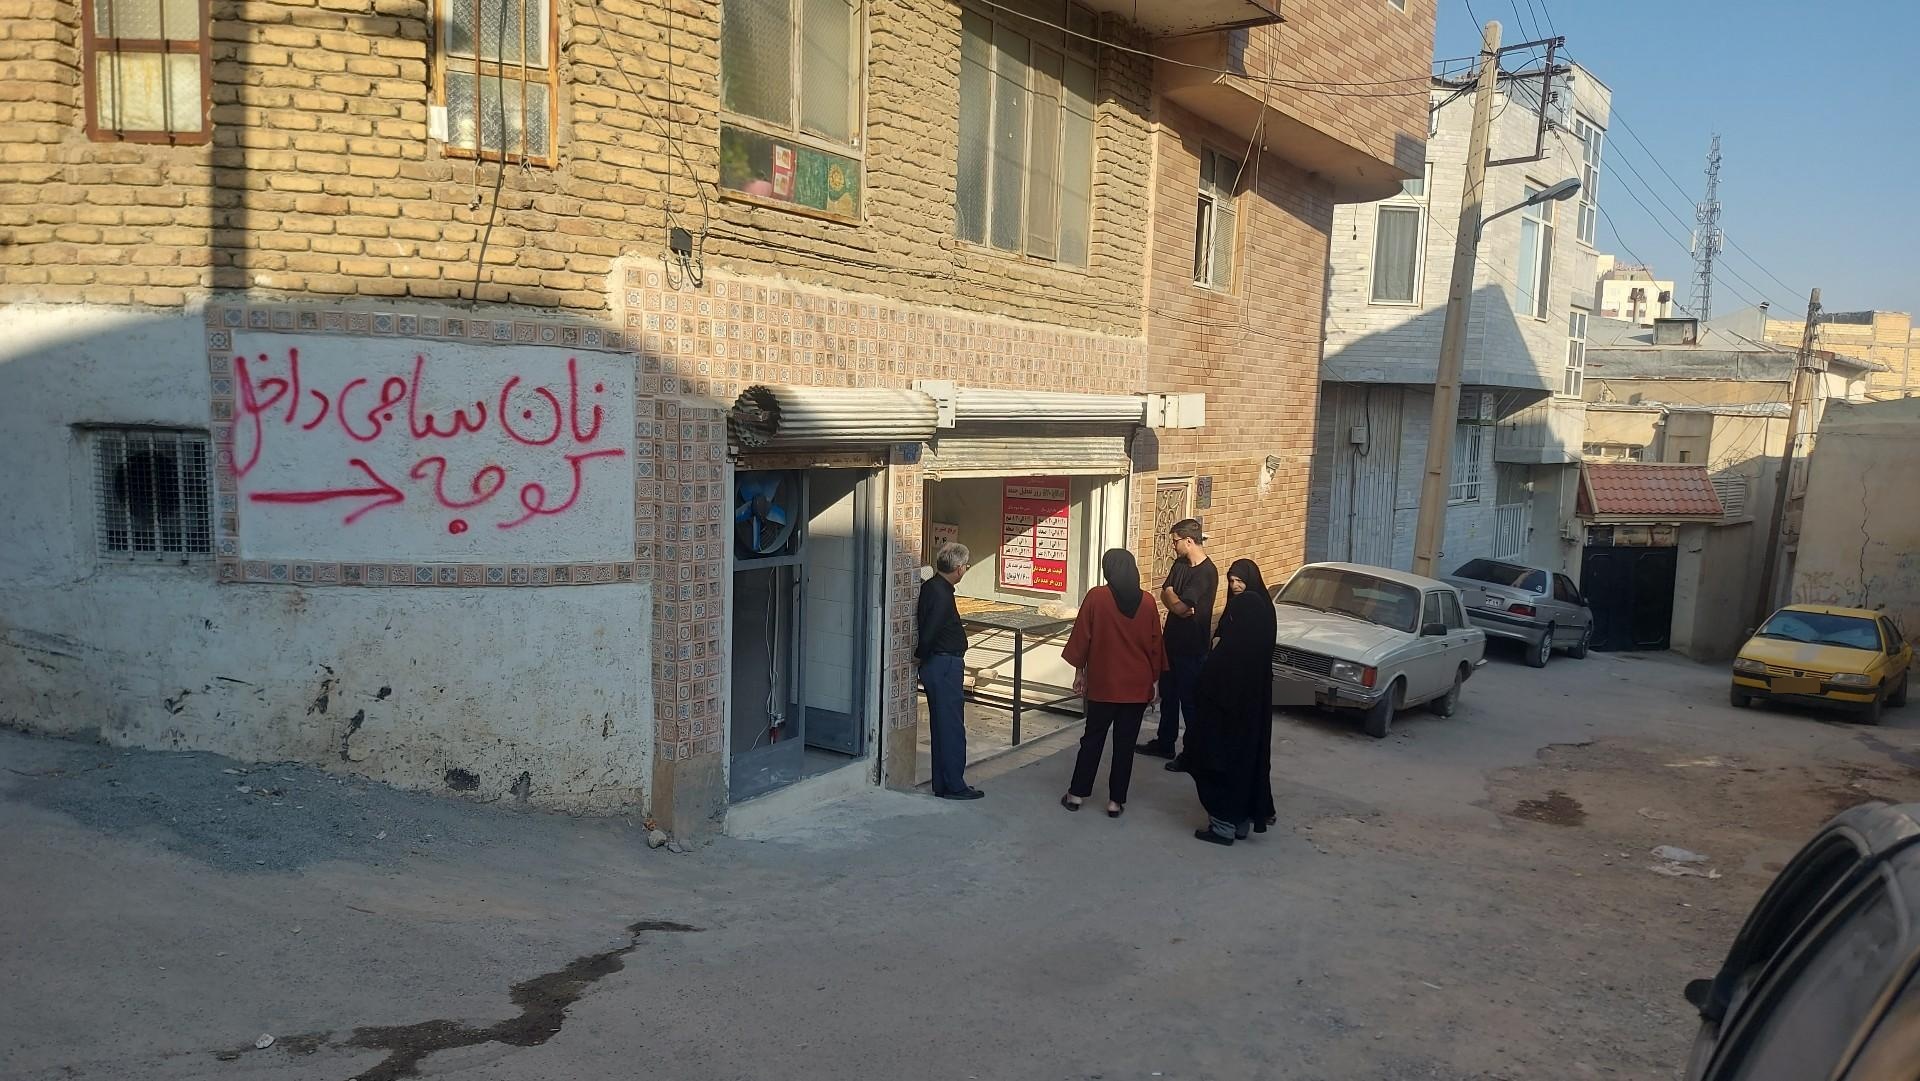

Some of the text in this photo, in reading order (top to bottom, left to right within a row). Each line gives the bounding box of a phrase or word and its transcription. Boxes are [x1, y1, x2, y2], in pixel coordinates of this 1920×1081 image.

[231, 347, 607, 478] نان ساجی داخل
